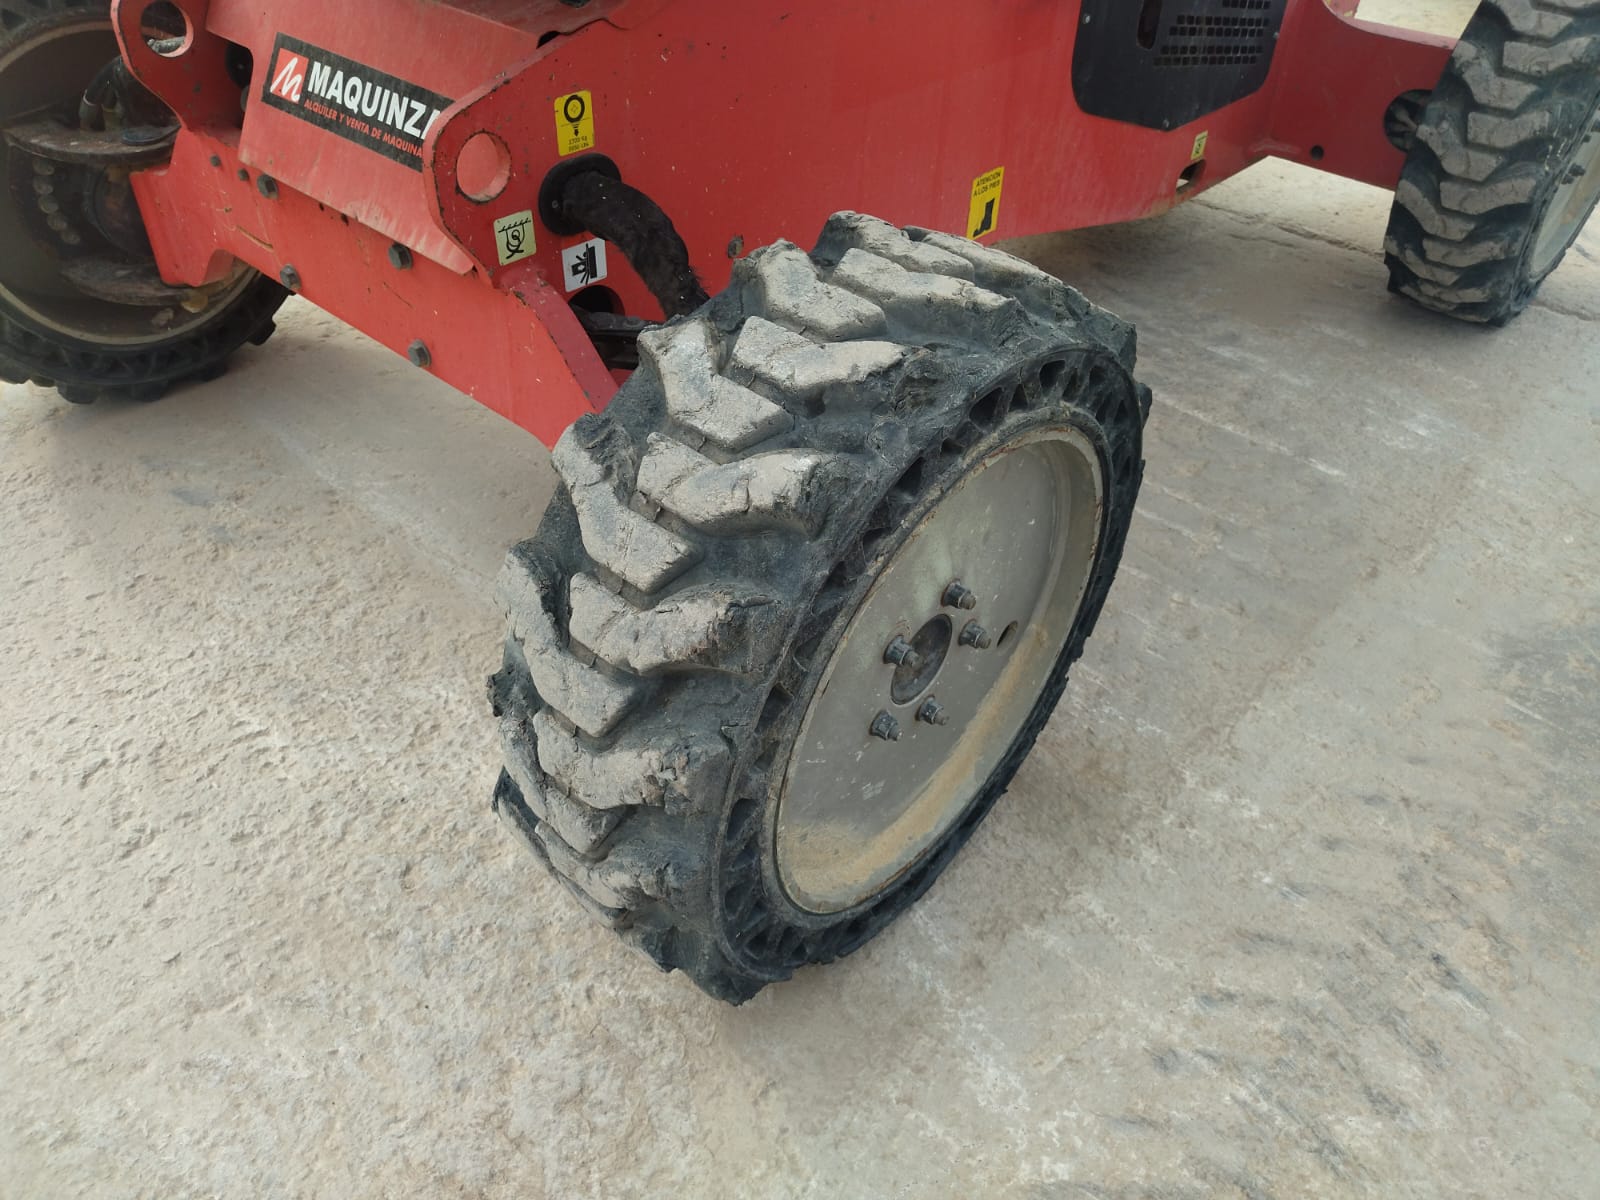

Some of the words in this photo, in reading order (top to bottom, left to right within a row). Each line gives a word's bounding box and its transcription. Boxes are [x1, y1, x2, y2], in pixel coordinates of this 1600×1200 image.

[304, 99, 337, 121] ALQUILER
[339, 112, 345, 122] Y
[346, 115, 370, 135] VENTA
[371, 127, 382, 140] DE
